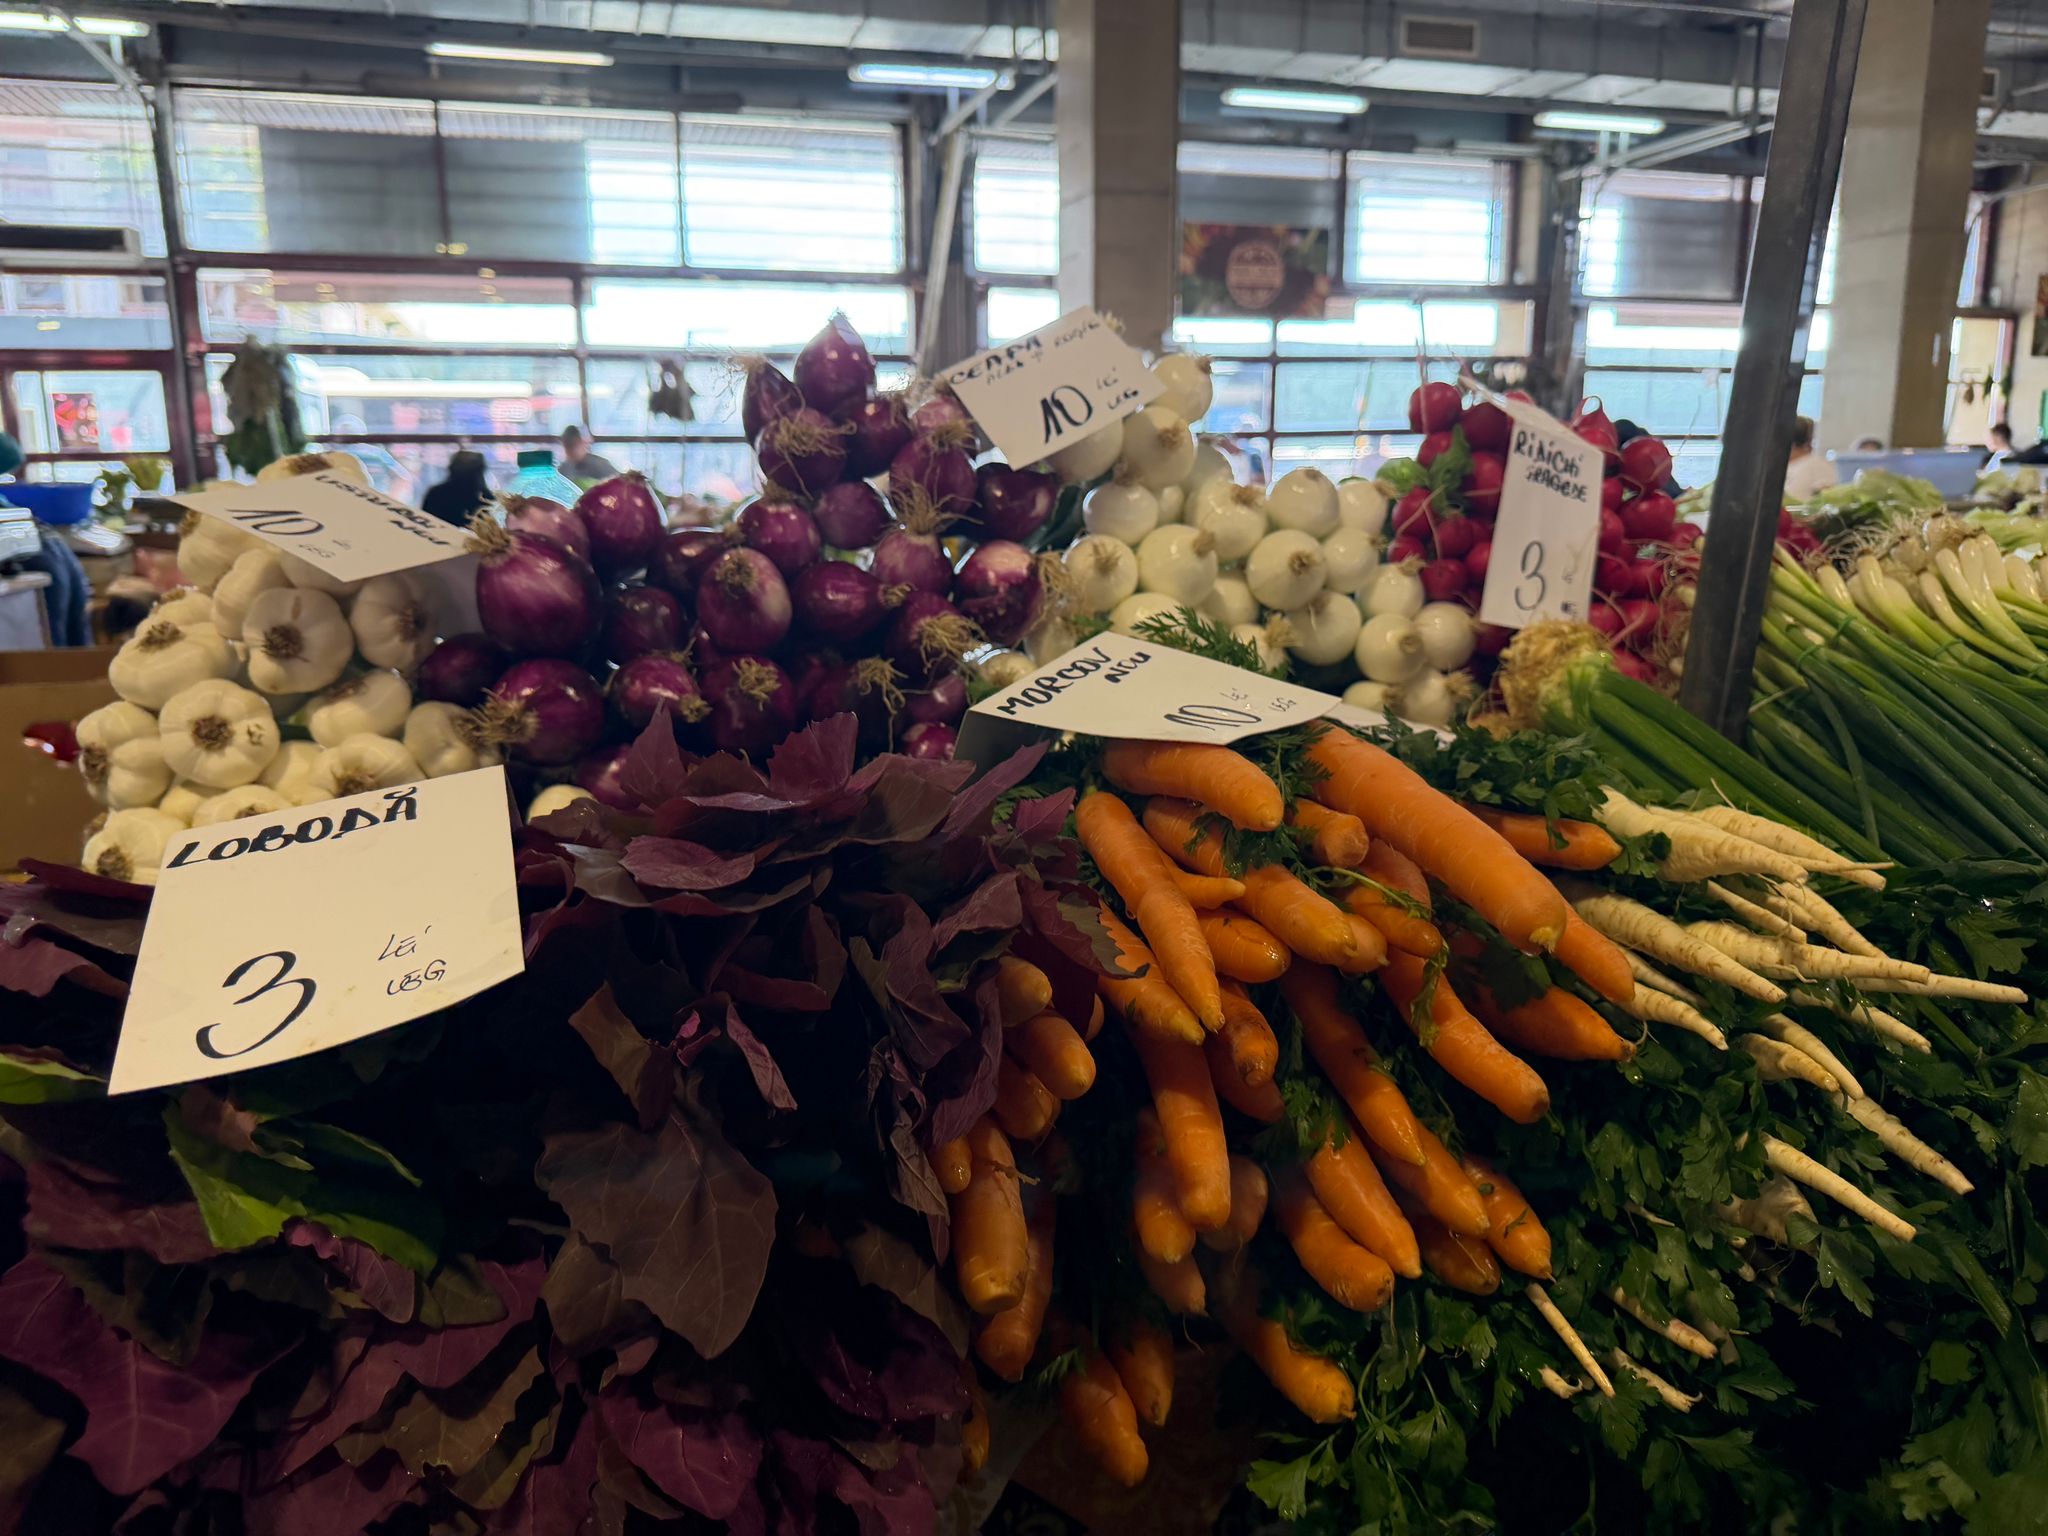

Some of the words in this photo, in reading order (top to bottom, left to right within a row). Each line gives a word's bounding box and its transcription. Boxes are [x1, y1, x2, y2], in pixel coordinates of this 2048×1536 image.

[1039, 385, 1093, 444] 10
[226, 508, 325, 535] 10
[1515, 541, 1546, 611] 3
[996, 646, 1113, 716] MORCOV
[1104, 651, 1152, 685] NOU
[1164, 703, 1263, 732] 10
[195, 950, 317, 1060] 3
